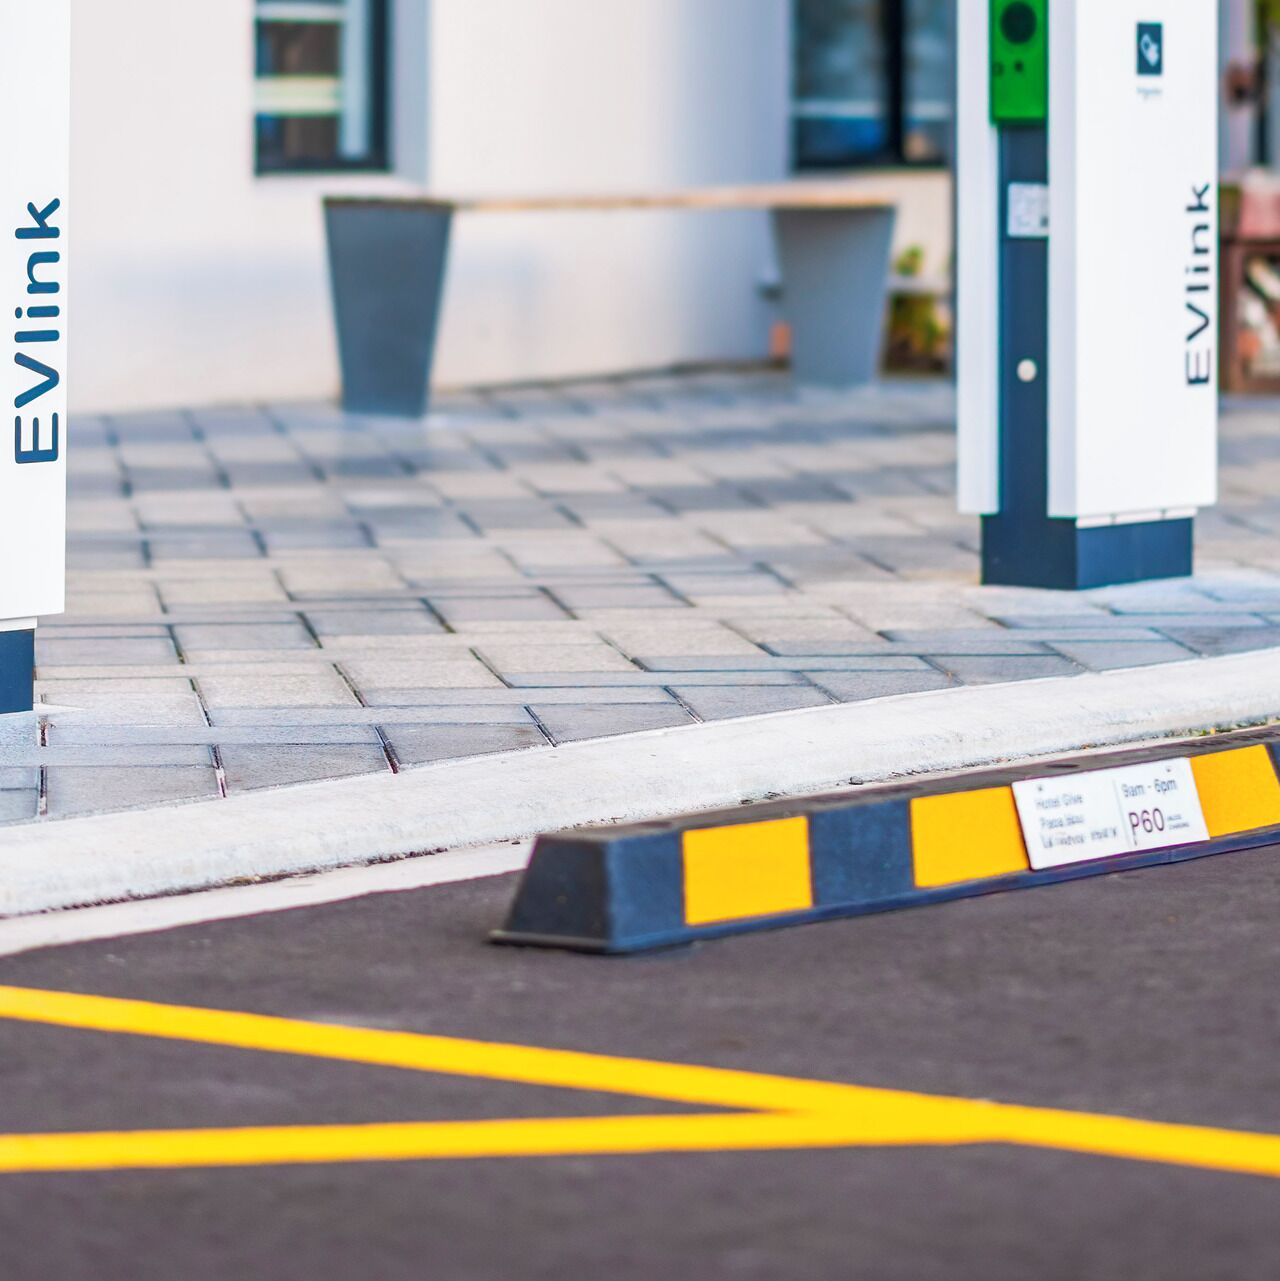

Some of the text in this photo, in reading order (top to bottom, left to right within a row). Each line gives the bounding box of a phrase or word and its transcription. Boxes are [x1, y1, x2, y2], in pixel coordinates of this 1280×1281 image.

[14, 197, 61, 464] EVlink
[1185, 183, 1210, 387] EVlink
[1128, 807, 1165, 846] P60
